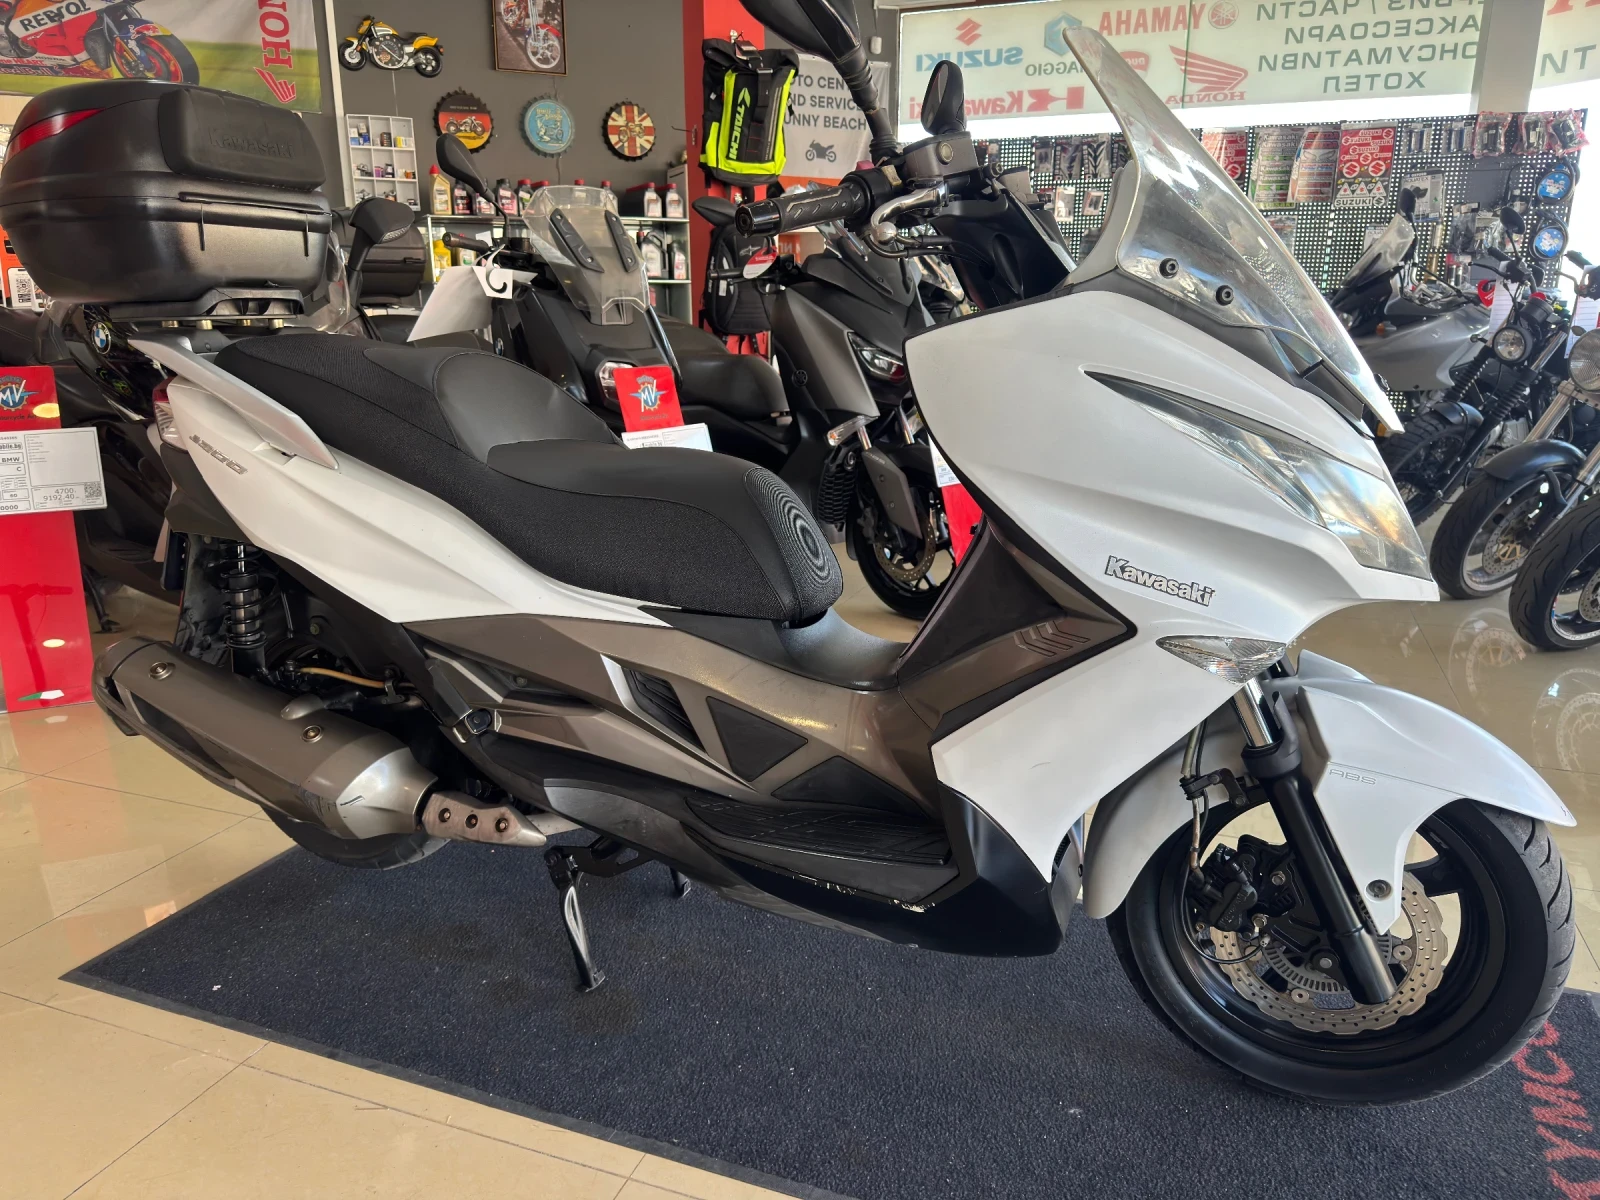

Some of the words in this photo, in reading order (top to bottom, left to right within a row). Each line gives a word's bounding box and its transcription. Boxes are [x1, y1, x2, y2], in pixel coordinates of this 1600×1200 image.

[817, 76, 850, 91] CEN
[823, 116, 867, 131] BEACH
[728, 105, 746, 160] TAICHI
[207, 126, 294, 159] Kawasaki
[1334, 197, 1373, 206] SUZUKI
[1104, 555, 1214, 607] Kawasaki
[1328, 768, 1377, 785] ABS
